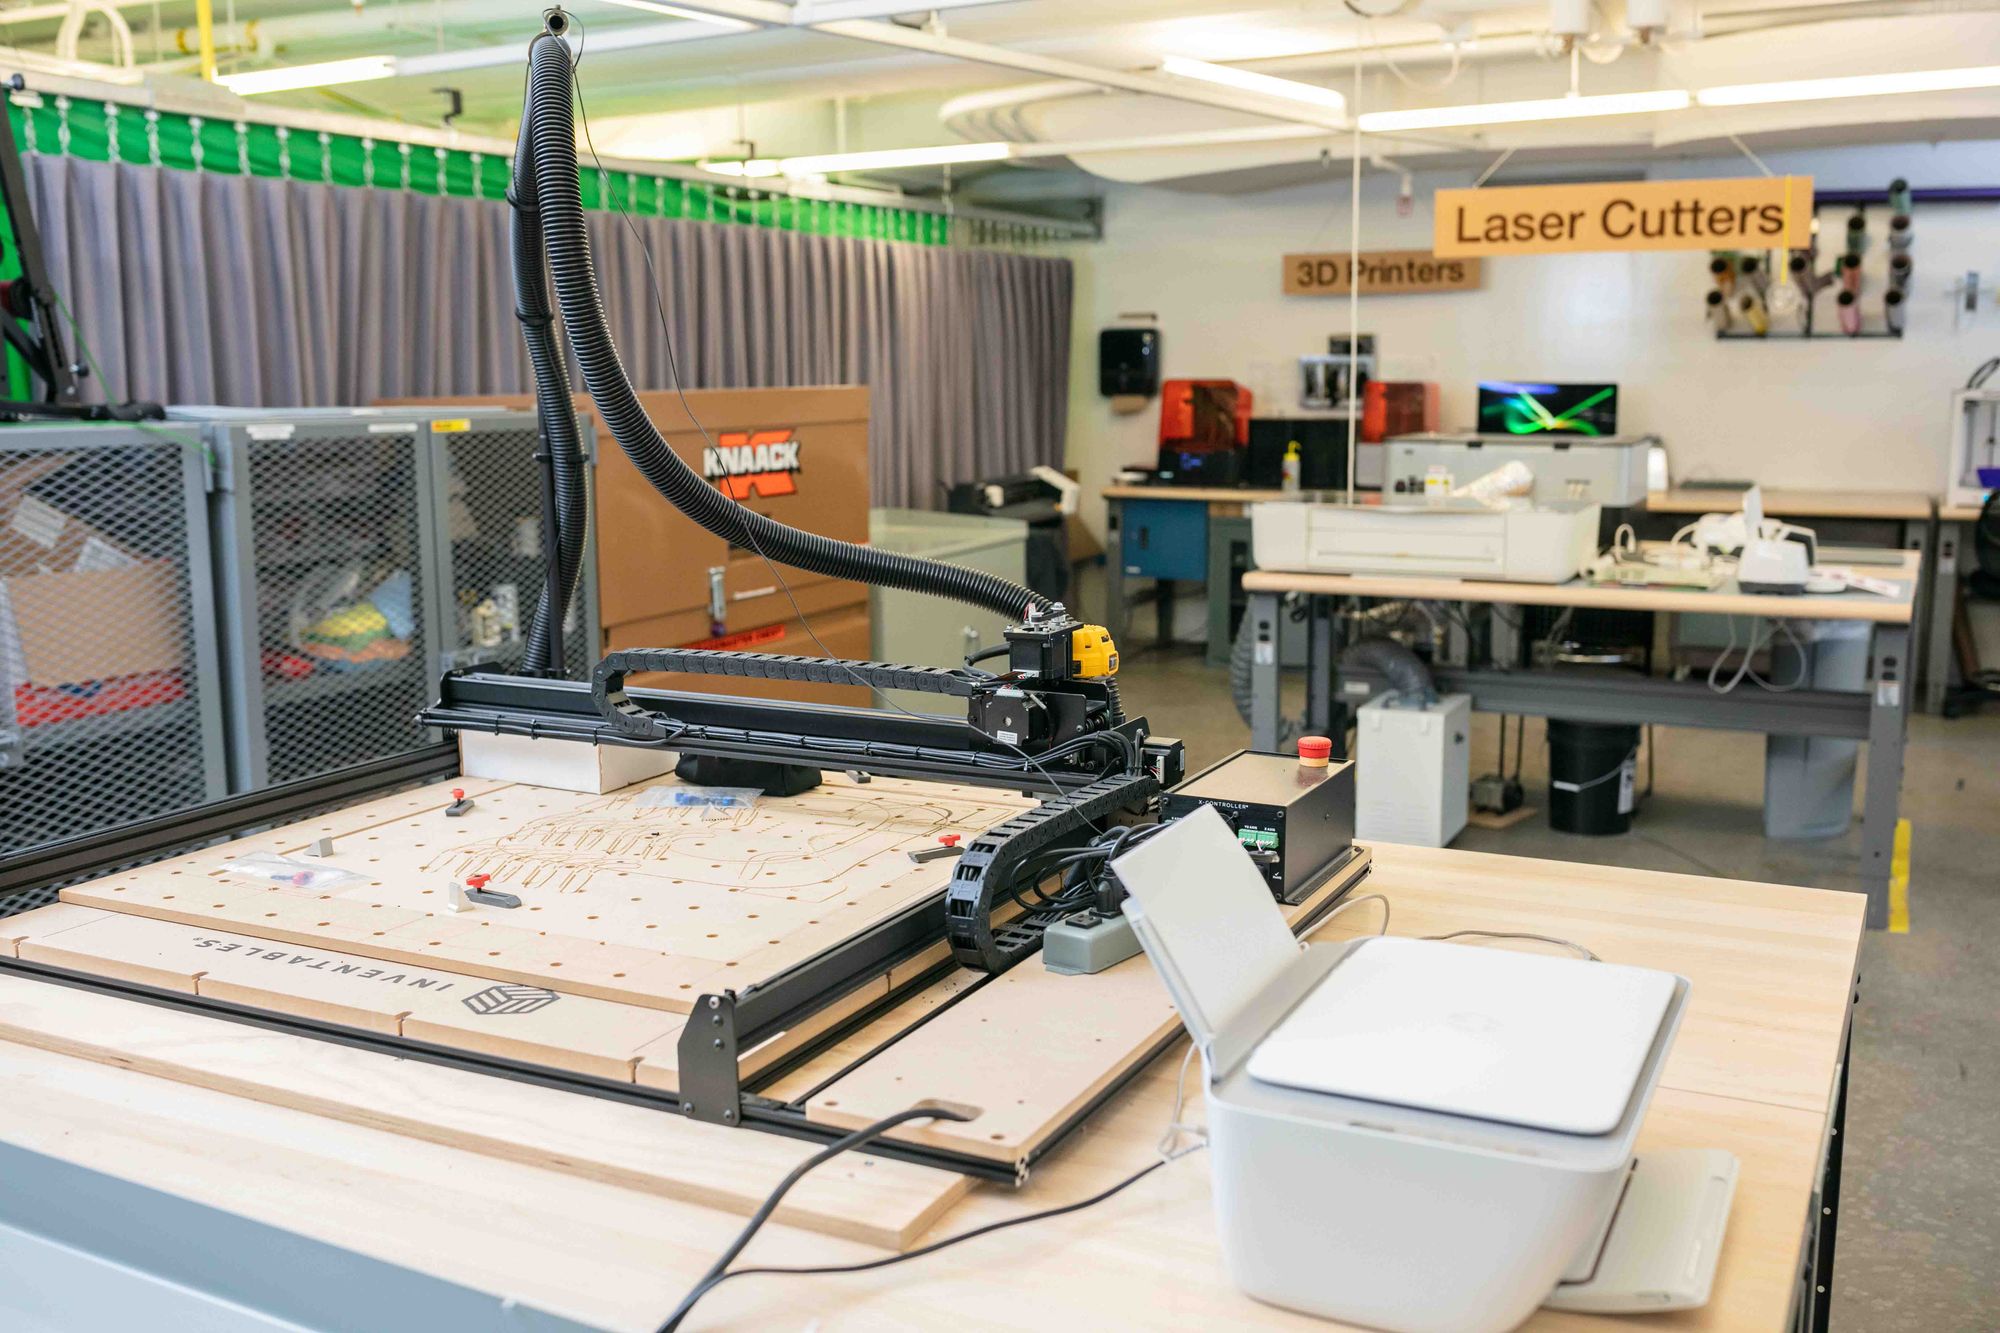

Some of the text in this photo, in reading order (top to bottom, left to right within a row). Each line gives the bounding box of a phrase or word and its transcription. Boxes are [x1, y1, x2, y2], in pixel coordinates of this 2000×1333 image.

[1456, 199, 1785, 243] Laser Cutters
[1296, 258, 1465, 288] 3D Printers
[703, 441, 801, 478] KNAACK
